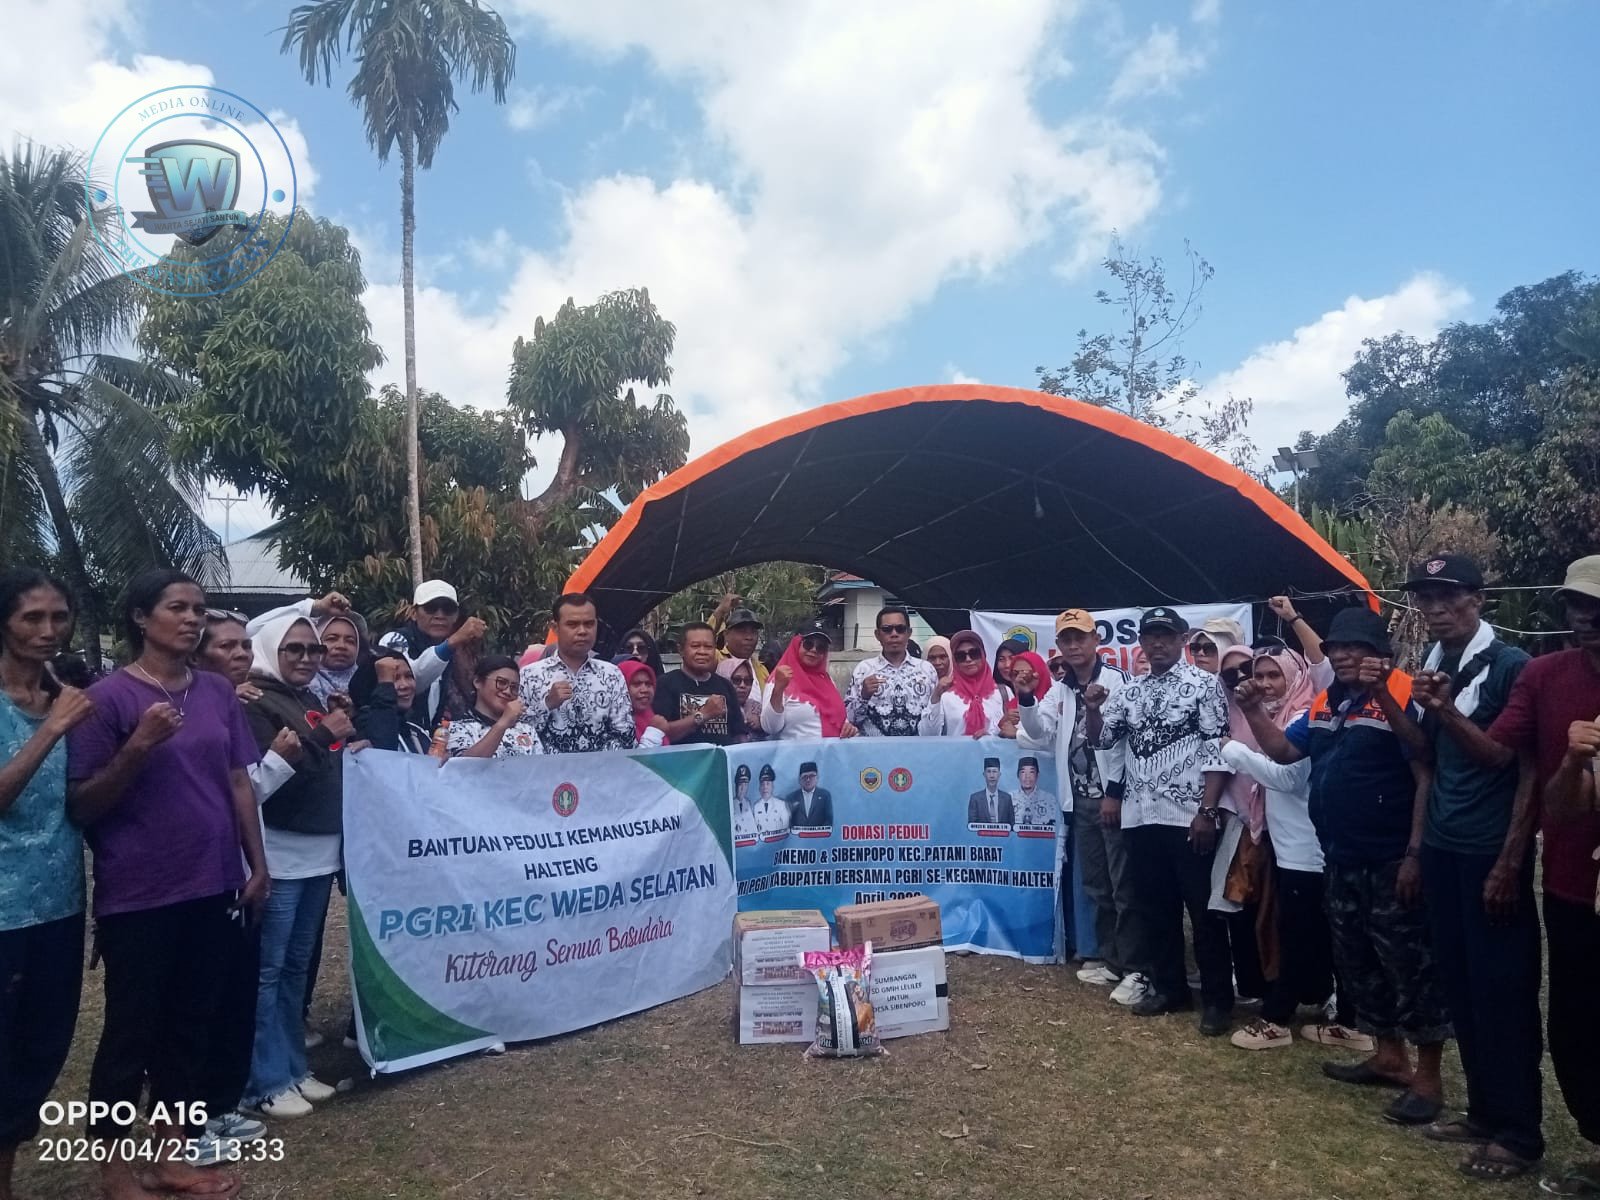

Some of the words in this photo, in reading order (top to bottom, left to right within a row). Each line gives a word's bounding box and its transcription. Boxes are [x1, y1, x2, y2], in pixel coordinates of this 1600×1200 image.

[407, 835, 501, 858] BANTUAN
[504, 832, 564, 851] PEDULI
[566, 815, 681, 846] KEMANUSIAAN
[842, 825, 885, 841] DONASI
[888, 824, 930, 840] PEDULI
[820, 851, 828, 863] &
[832, 847, 894, 863] SIBENPOPO
[899, 846, 966, 862] KEC.PATANI
[970, 847, 1003, 862] BARAT
[524, 857, 598, 880] HALTENG
[770, 871, 831, 887] KABUPATEN
[835, 869, 891, 884] BERSAMA
[895, 869, 922, 884] PGRI
[926, 869, 1009, 886] SE-KECAMATAN
[378, 903, 476, 940] PGRI
[484, 894, 546, 929] KEC
[551, 883, 625, 918] WEDA
[629, 863, 717, 903] SELATAN
[444, 947, 538, 984] Kitorang
[545, 937, 603, 967] Semua
[605, 915, 675, 952] Basudara
[875, 973, 917, 984] SUMBANGAN
[901, 982, 922, 991] LELILEF
[891, 1000, 926, 1010] SIBENPOPO
